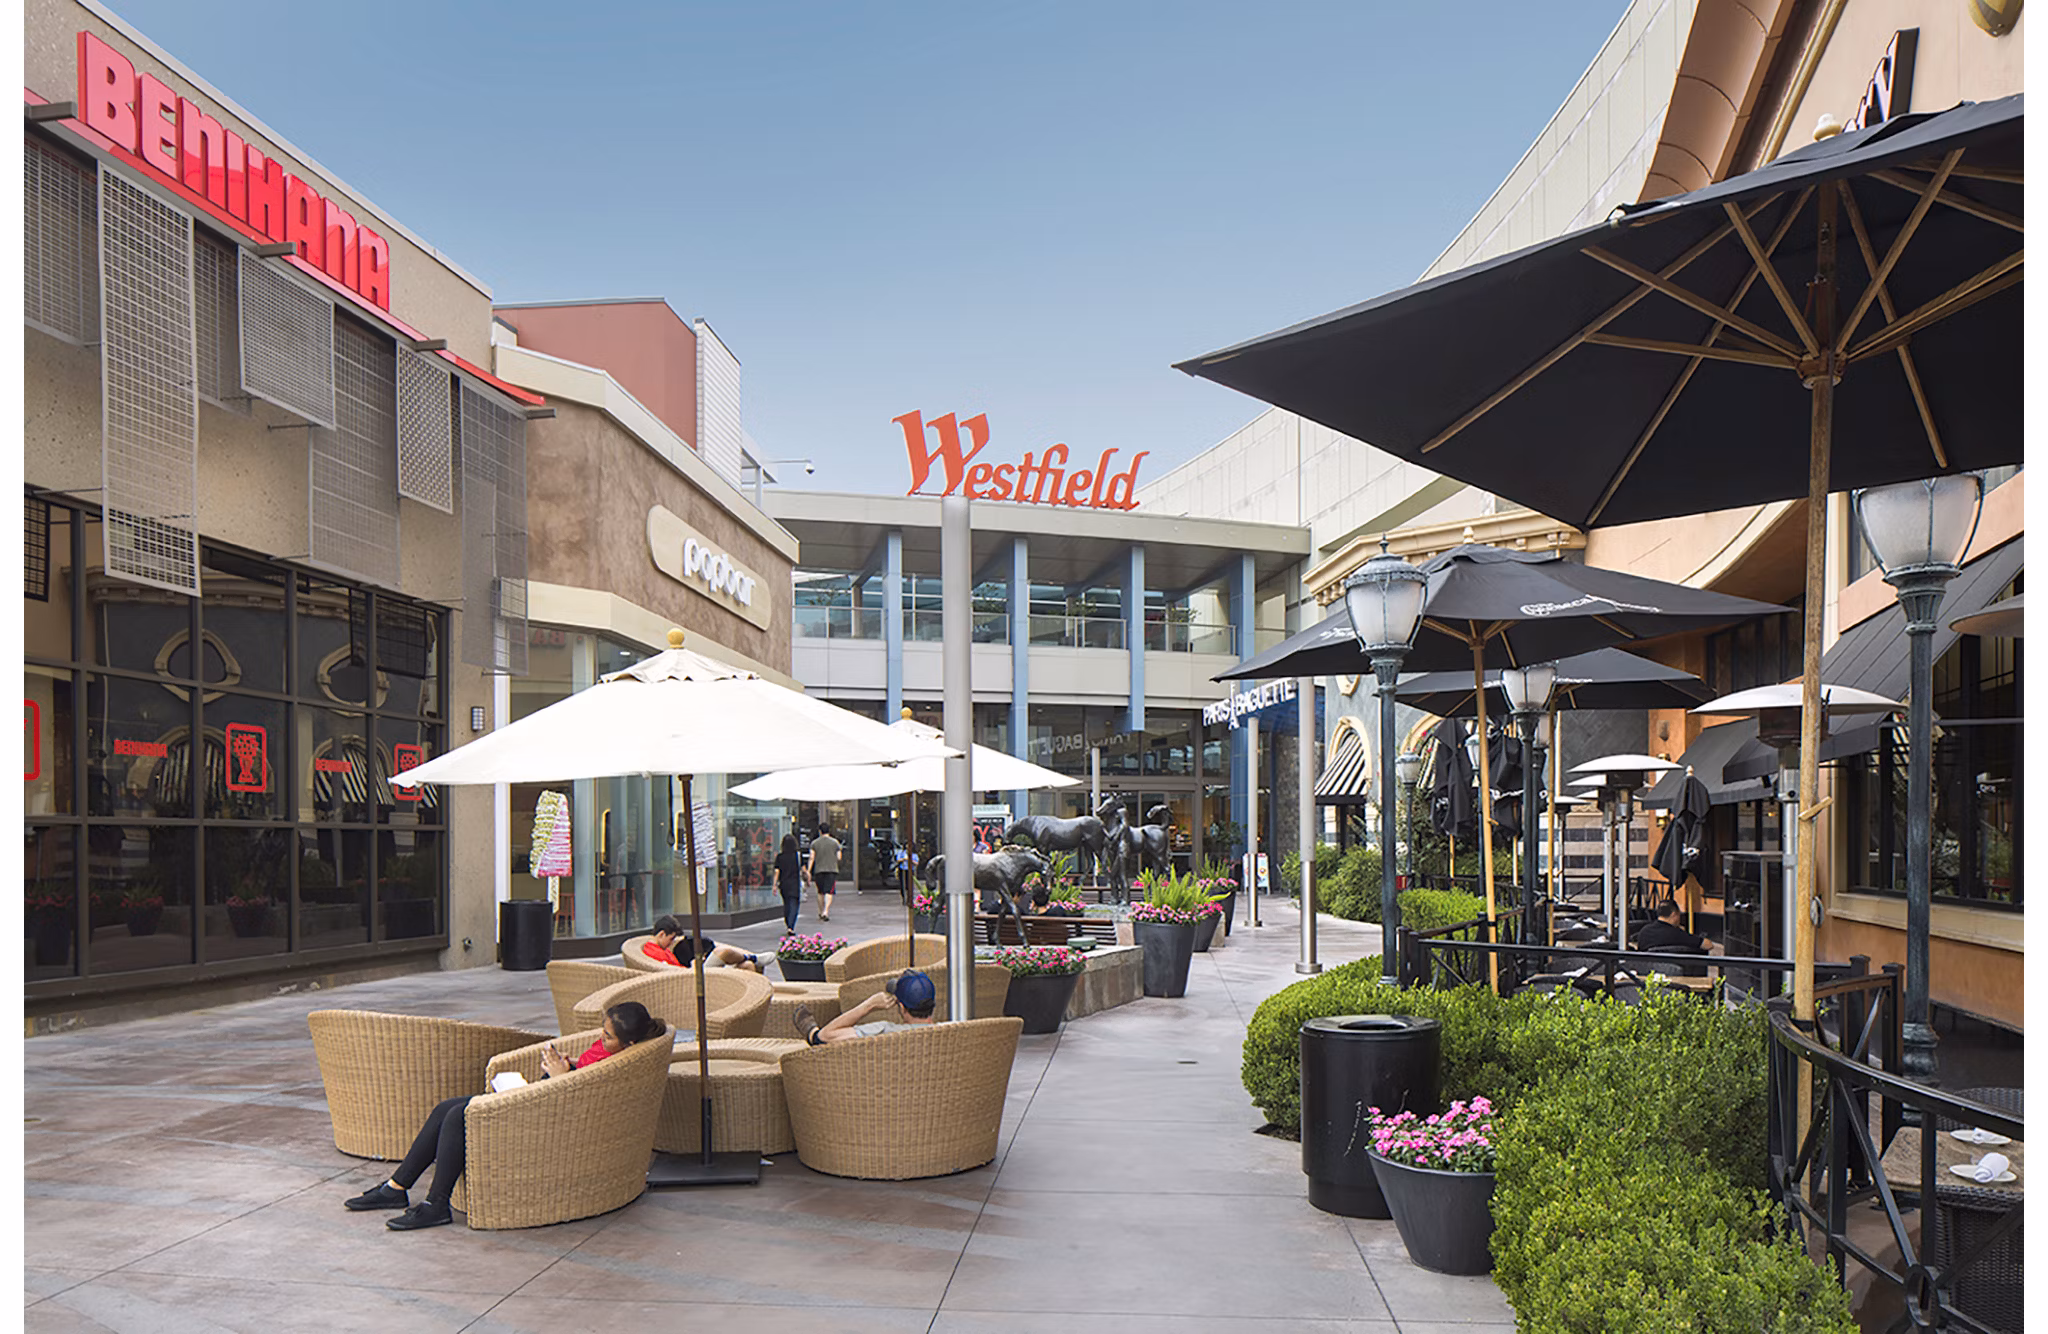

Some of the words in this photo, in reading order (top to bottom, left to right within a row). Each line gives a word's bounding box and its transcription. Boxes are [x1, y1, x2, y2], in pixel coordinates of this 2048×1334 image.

[77, 31, 390, 313] BENIHANA
[891, 409, 1150, 511] Westfield
[683, 538, 756, 607] popbar
[1203, 698, 1231, 727] PARIS
[1235, 677, 1297, 716] BAGUETTE
